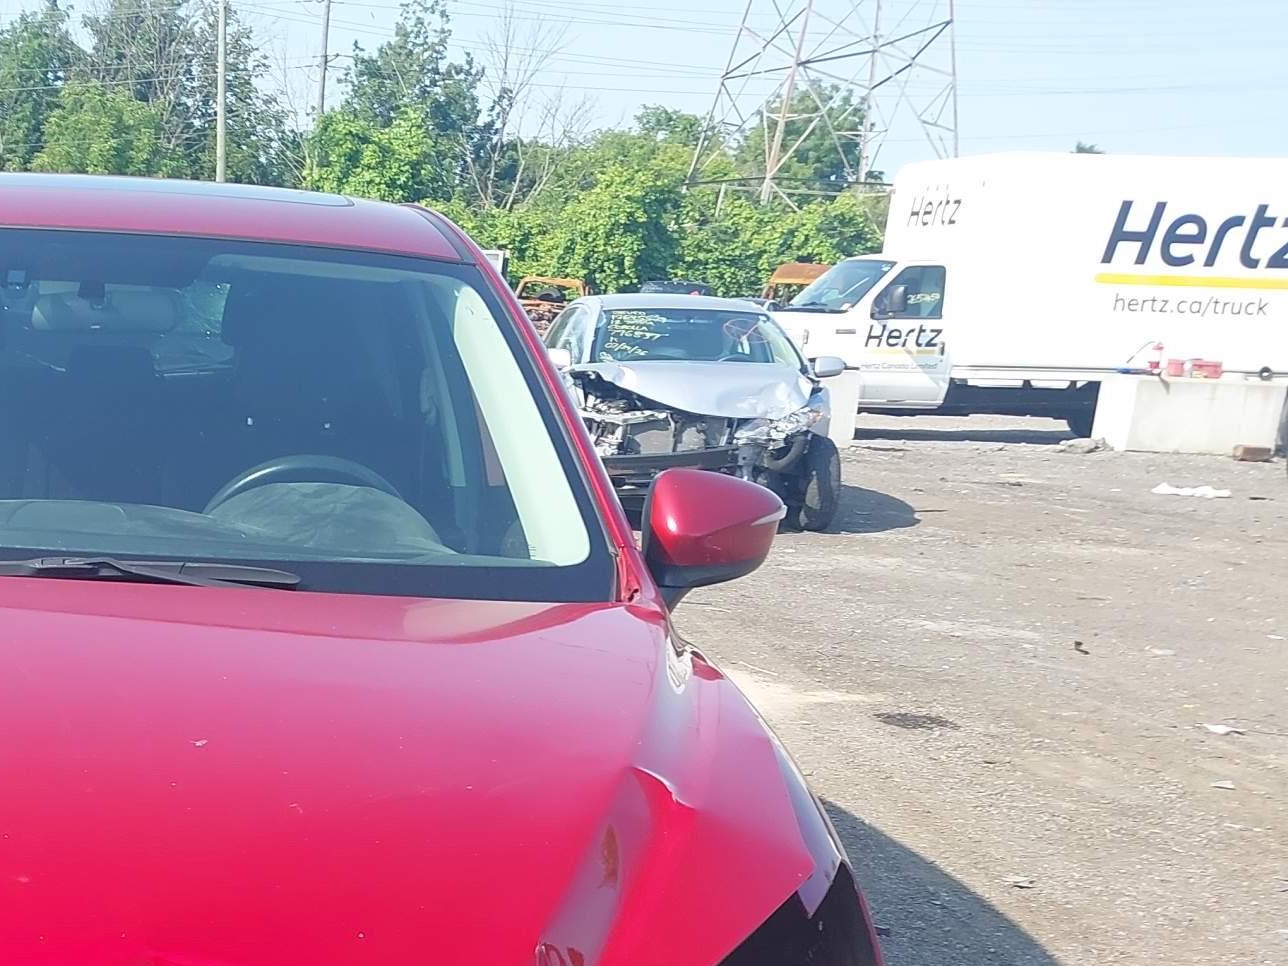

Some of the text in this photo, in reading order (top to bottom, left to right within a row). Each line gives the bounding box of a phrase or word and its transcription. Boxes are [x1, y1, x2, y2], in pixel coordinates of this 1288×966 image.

[907, 193, 962, 227] Hertz
[1112, 292, 1269, 317] hertz.ca/truck
[865, 324, 943, 348] Hertz
